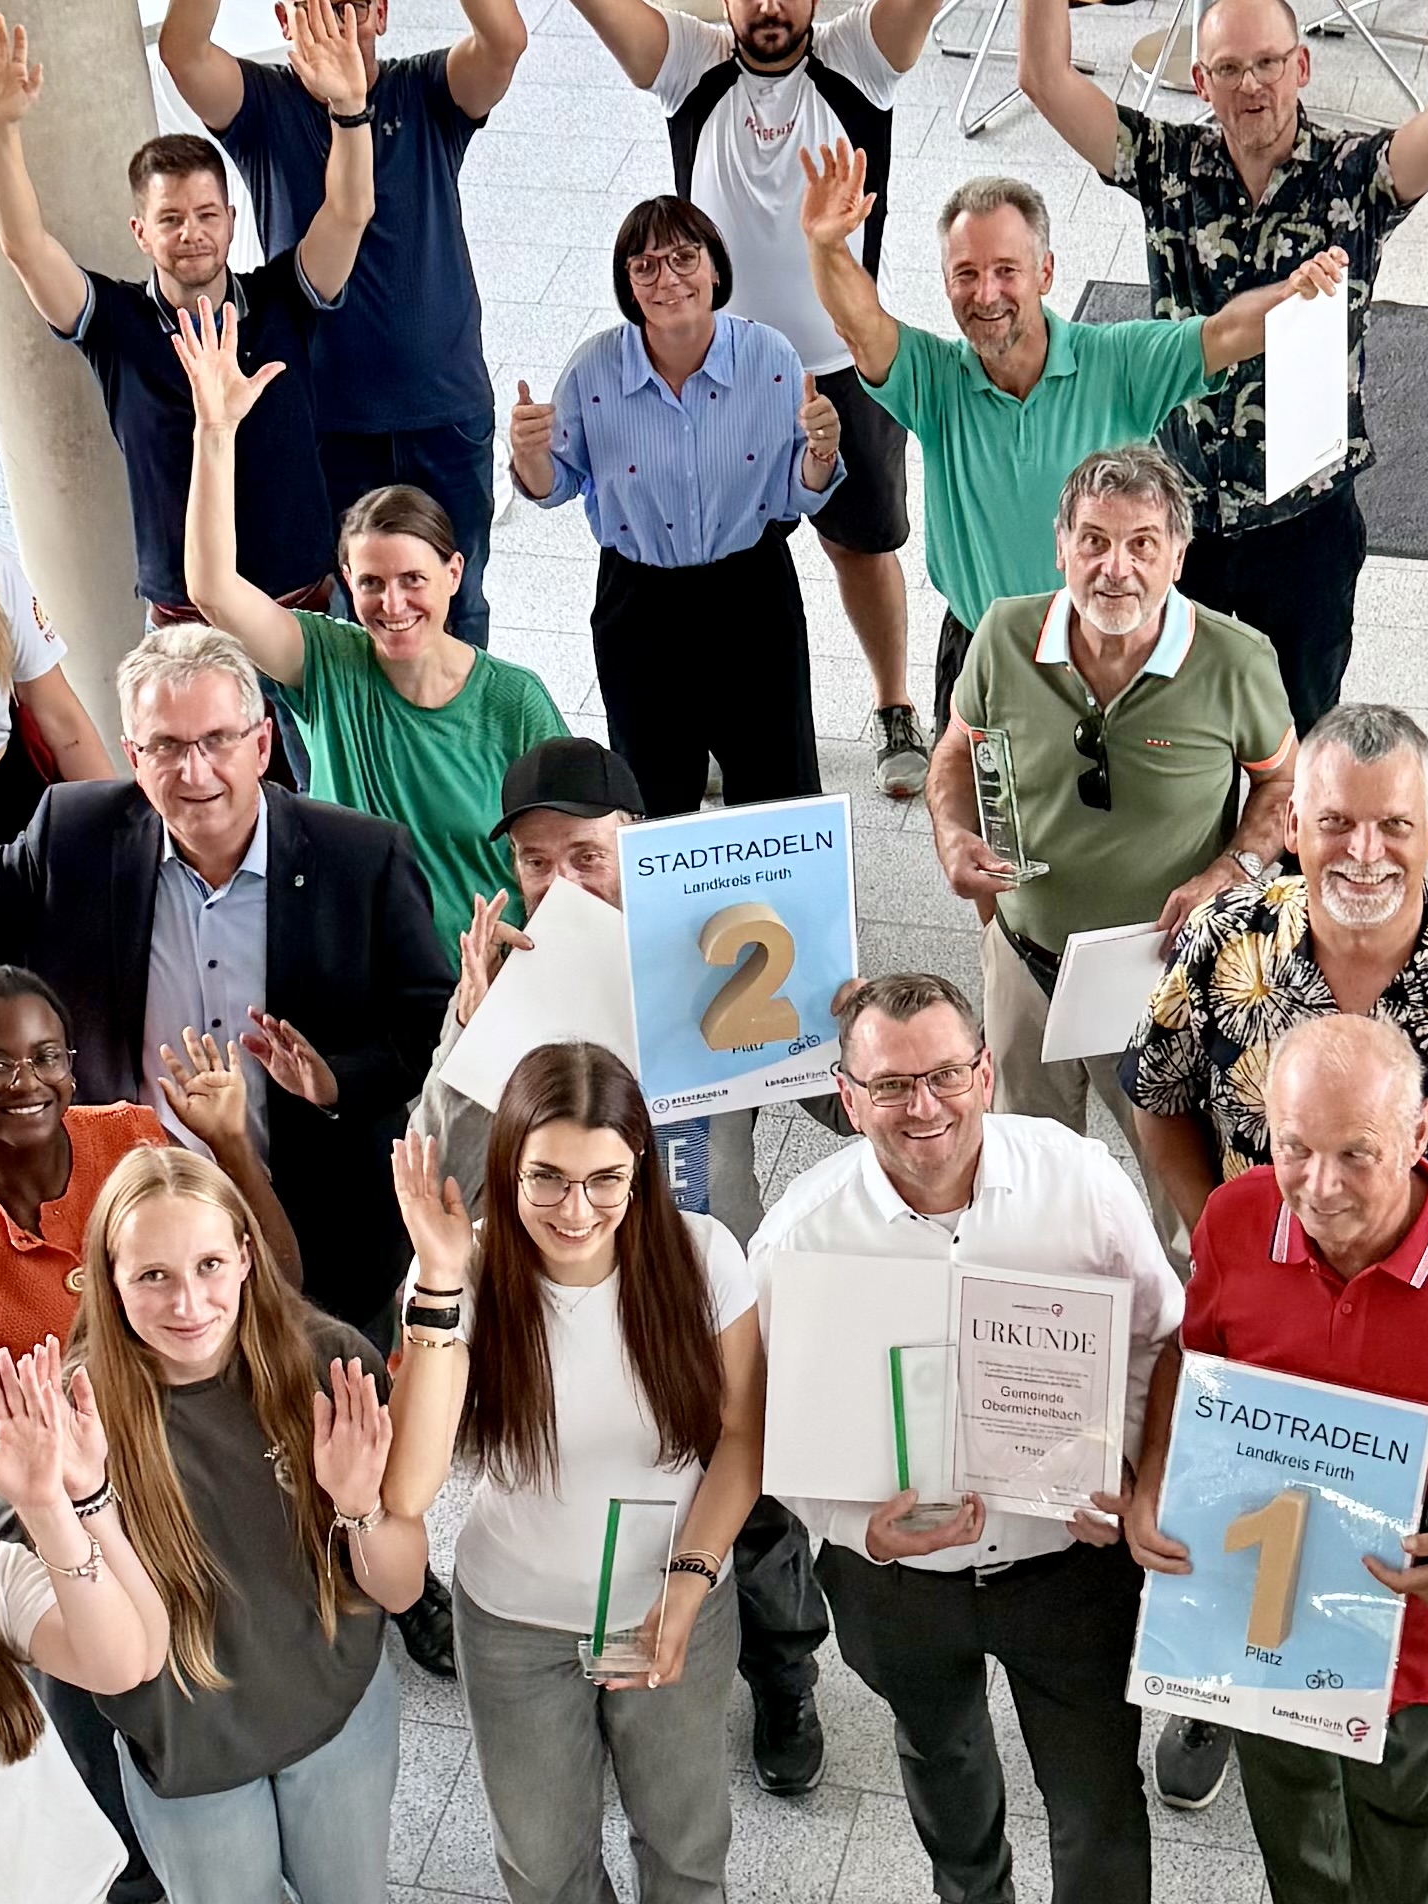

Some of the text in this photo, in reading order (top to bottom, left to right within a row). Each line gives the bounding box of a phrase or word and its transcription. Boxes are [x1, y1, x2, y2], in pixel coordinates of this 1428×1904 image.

[637, 829, 834, 878] STADTRADELN
[683, 867, 792, 895] Landkreis Fürth
[698, 901, 800, 1052] 2
[971, 1317, 1097, 1355] URKUNDE
[981, 1398, 1082, 1423] Obermichelbach
[1000, 1384, 1064, 1404] Gemeinde
[1194, 1395, 1409, 1465] STADTRADELN
[1236, 1442, 1355, 1482] Landkreis Fürth
[1223, 1488, 1310, 1650] 1
[1245, 1644, 1283, 1667] Platz
